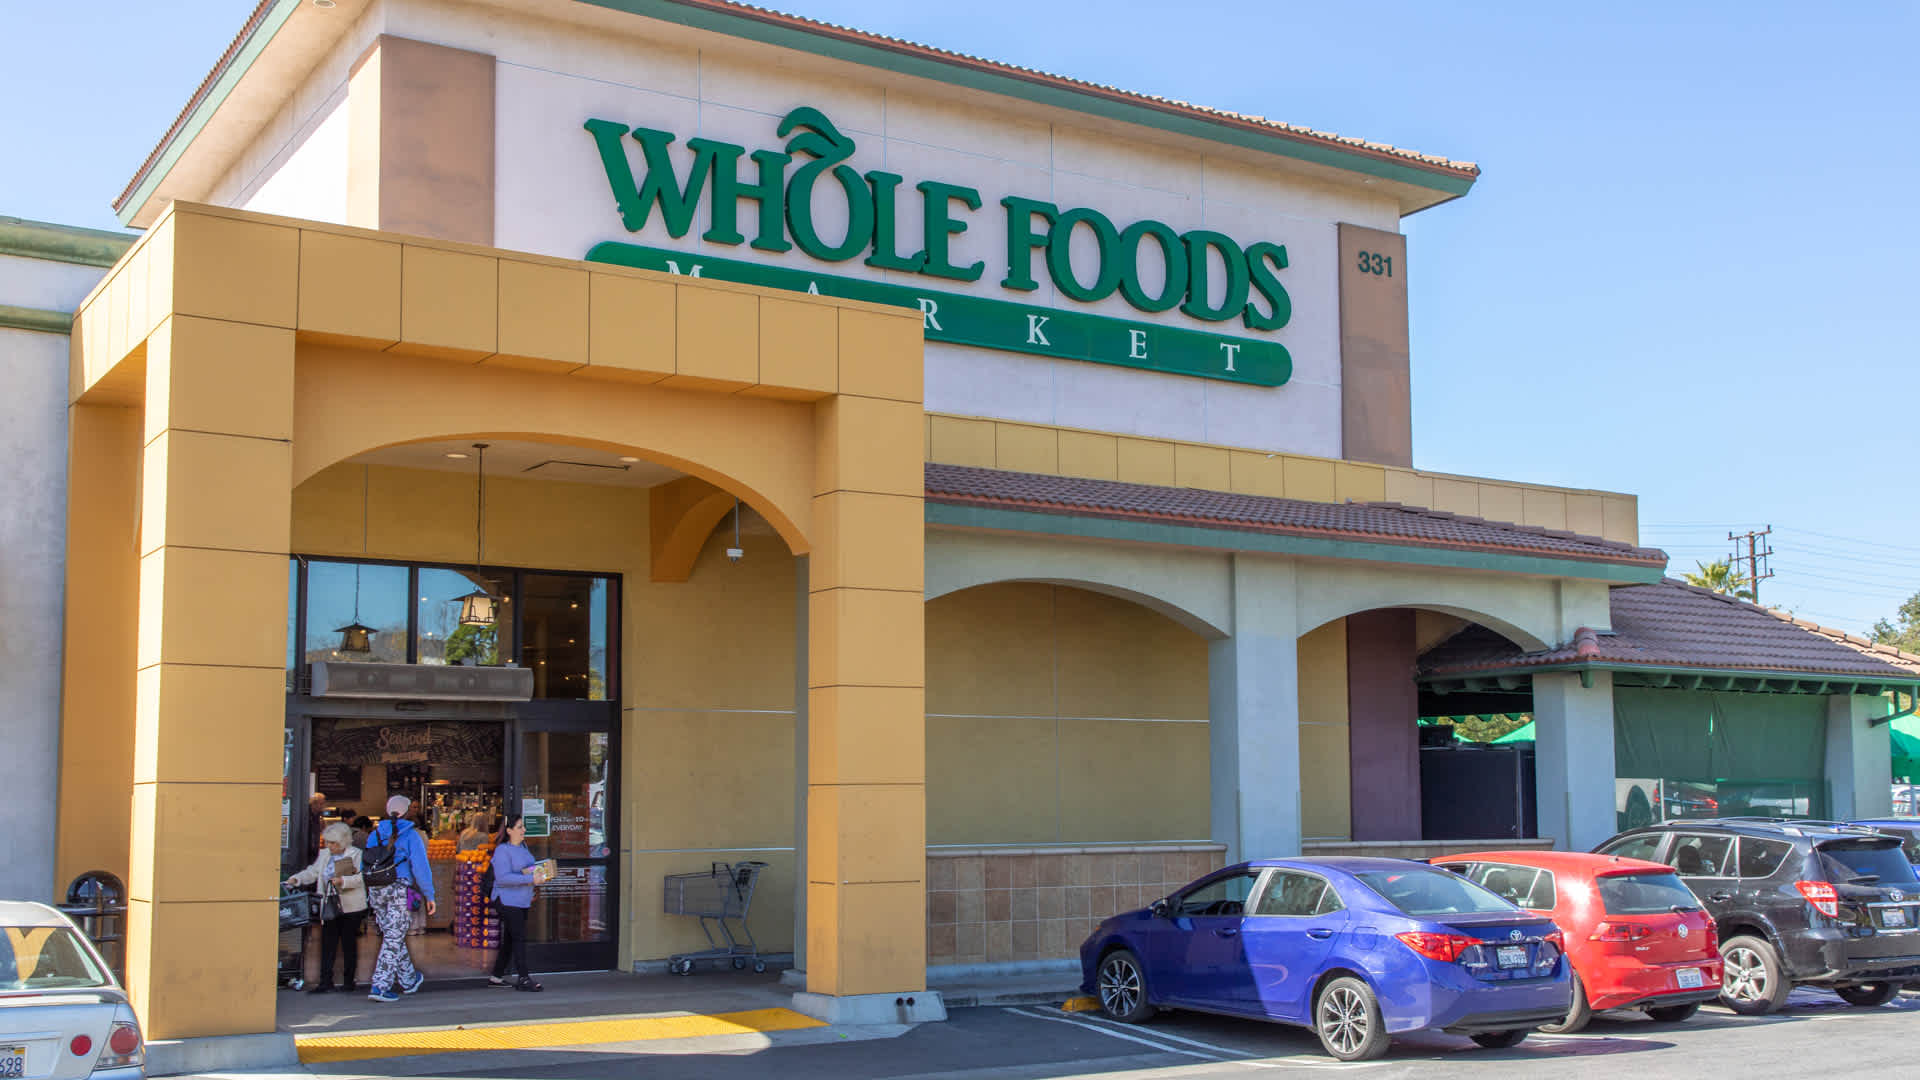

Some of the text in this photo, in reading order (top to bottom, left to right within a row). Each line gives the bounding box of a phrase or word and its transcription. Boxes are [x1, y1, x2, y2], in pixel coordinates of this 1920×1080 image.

[584, 106, 1293, 331] WHOLE FOODS
[1357, 251, 1394, 278] 331
[376, 723, 432, 750] Seafood
